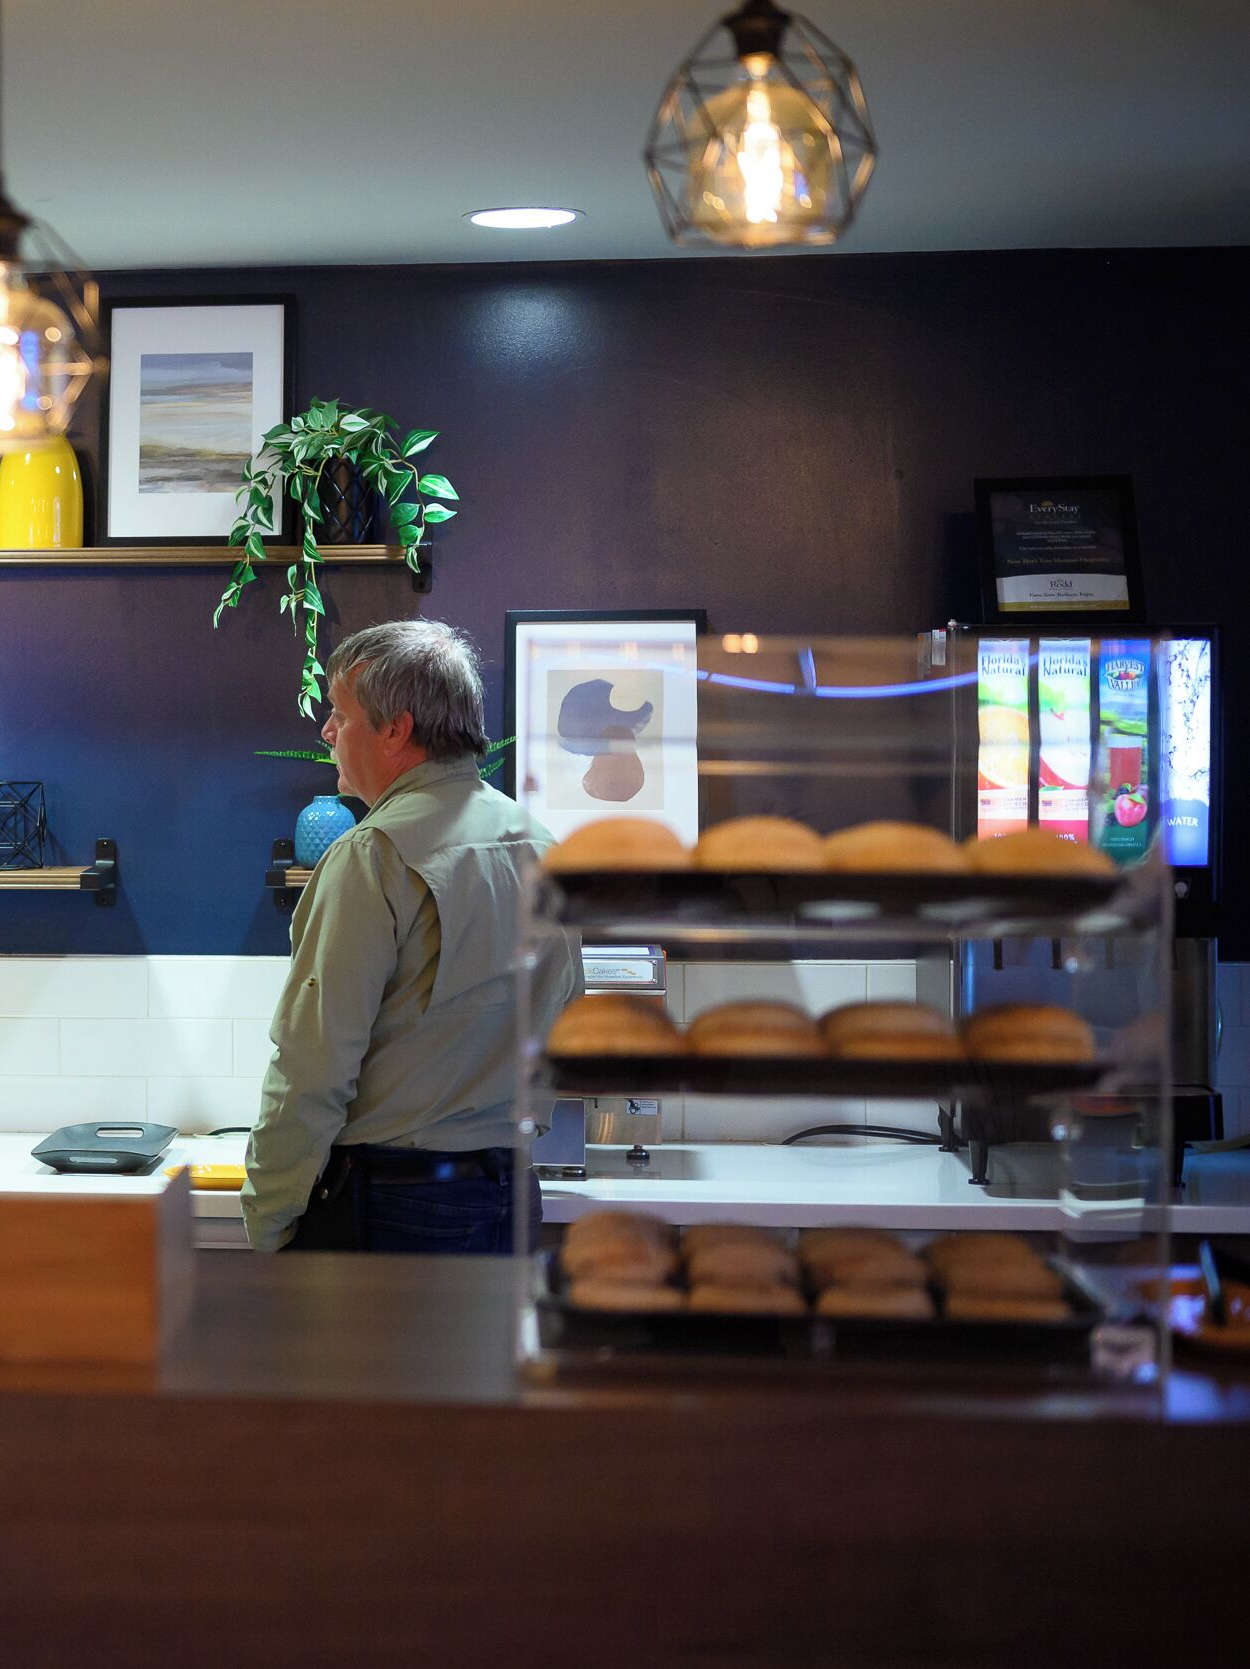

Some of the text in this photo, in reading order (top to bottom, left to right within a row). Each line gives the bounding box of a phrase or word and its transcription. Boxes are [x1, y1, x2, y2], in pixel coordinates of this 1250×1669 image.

[1029, 504, 1079, 514] EveryStay
[981, 665, 1025, 677] Natural
[1043, 665, 1087, 677] Natural
[1106, 660, 1144, 672] HARVEST
[1110, 679, 1141, 691] VALLEY
[1167, 816, 1199, 827] WATER
